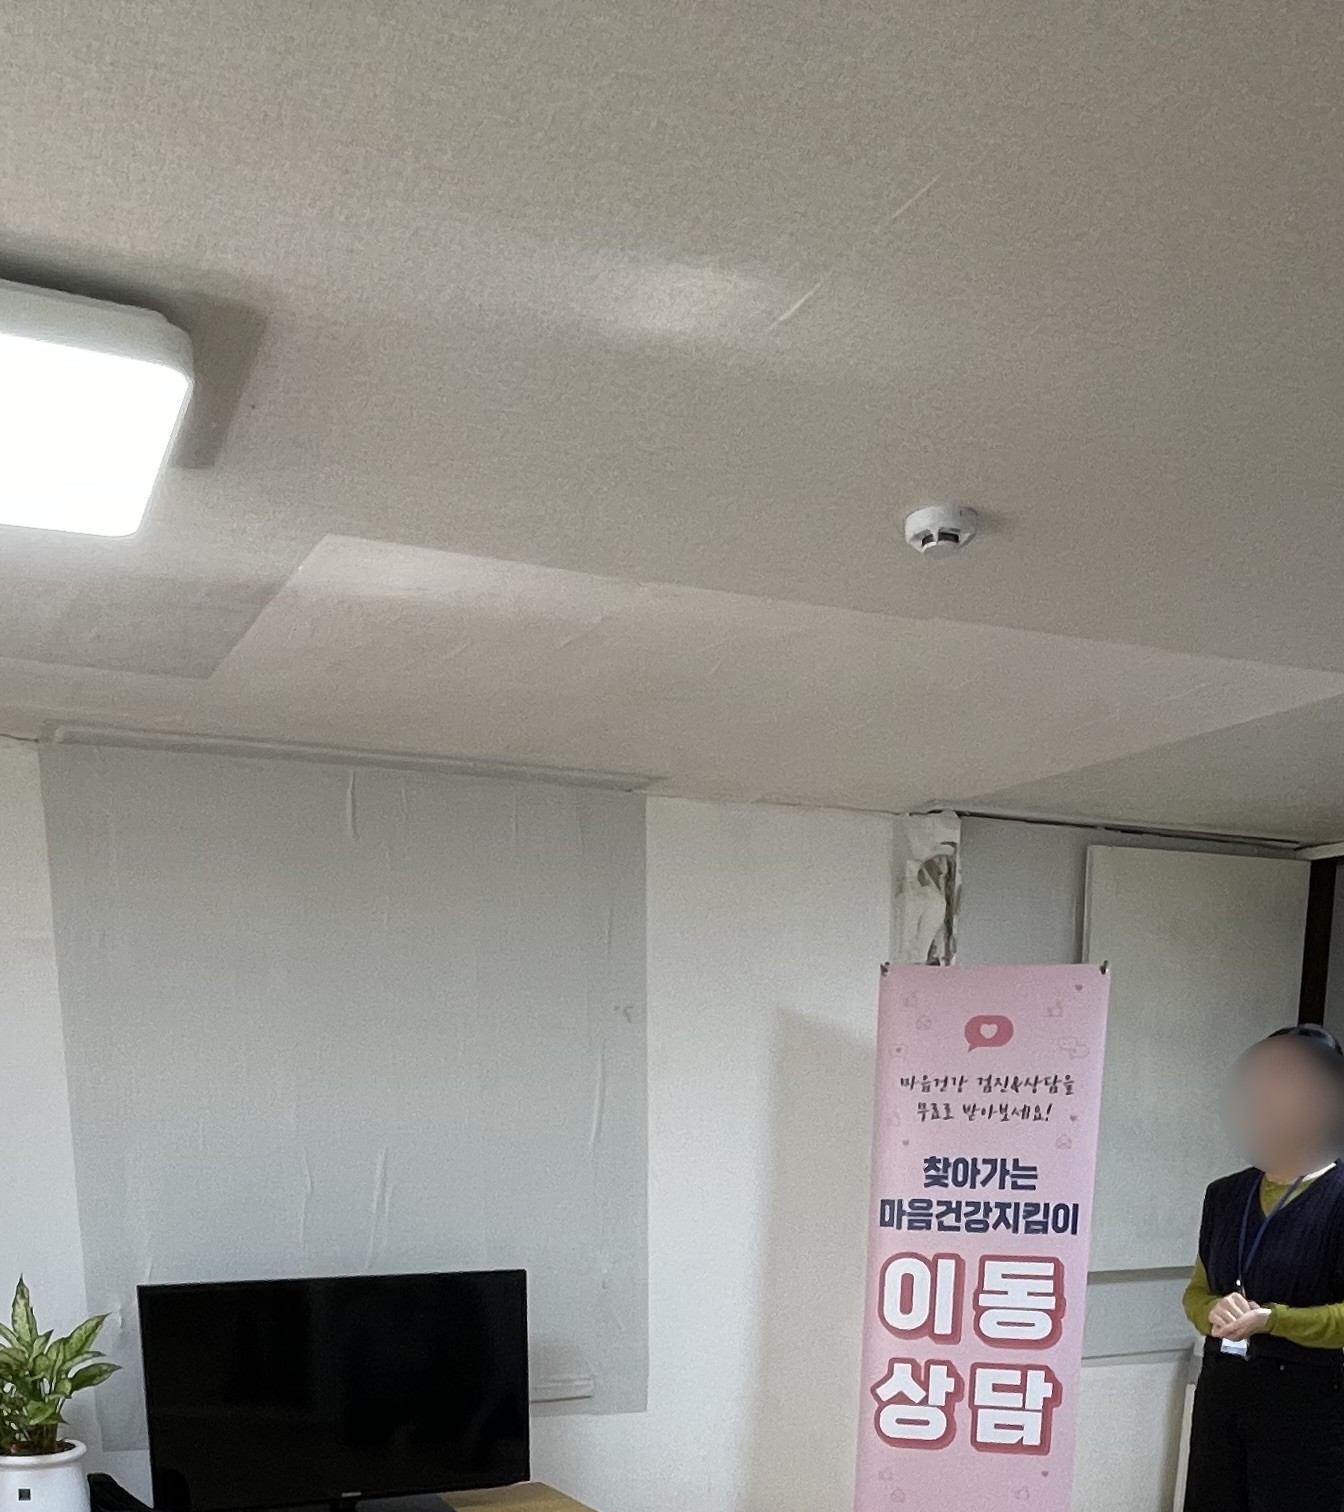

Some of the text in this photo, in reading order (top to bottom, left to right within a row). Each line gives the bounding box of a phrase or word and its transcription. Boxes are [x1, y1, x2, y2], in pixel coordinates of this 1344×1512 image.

[900, 1074, 1075, 1096] 마음건강 검진&상담을
[917, 1102, 1053, 1122] 무료로 받아보세요!
[923, 1156, 1038, 1191] 찾아가는
[879, 1199, 1079, 1235] 마음건강지킴이
[878, 1252, 1066, 1348] 이동
[871, 1358, 1063, 1455] 상담
